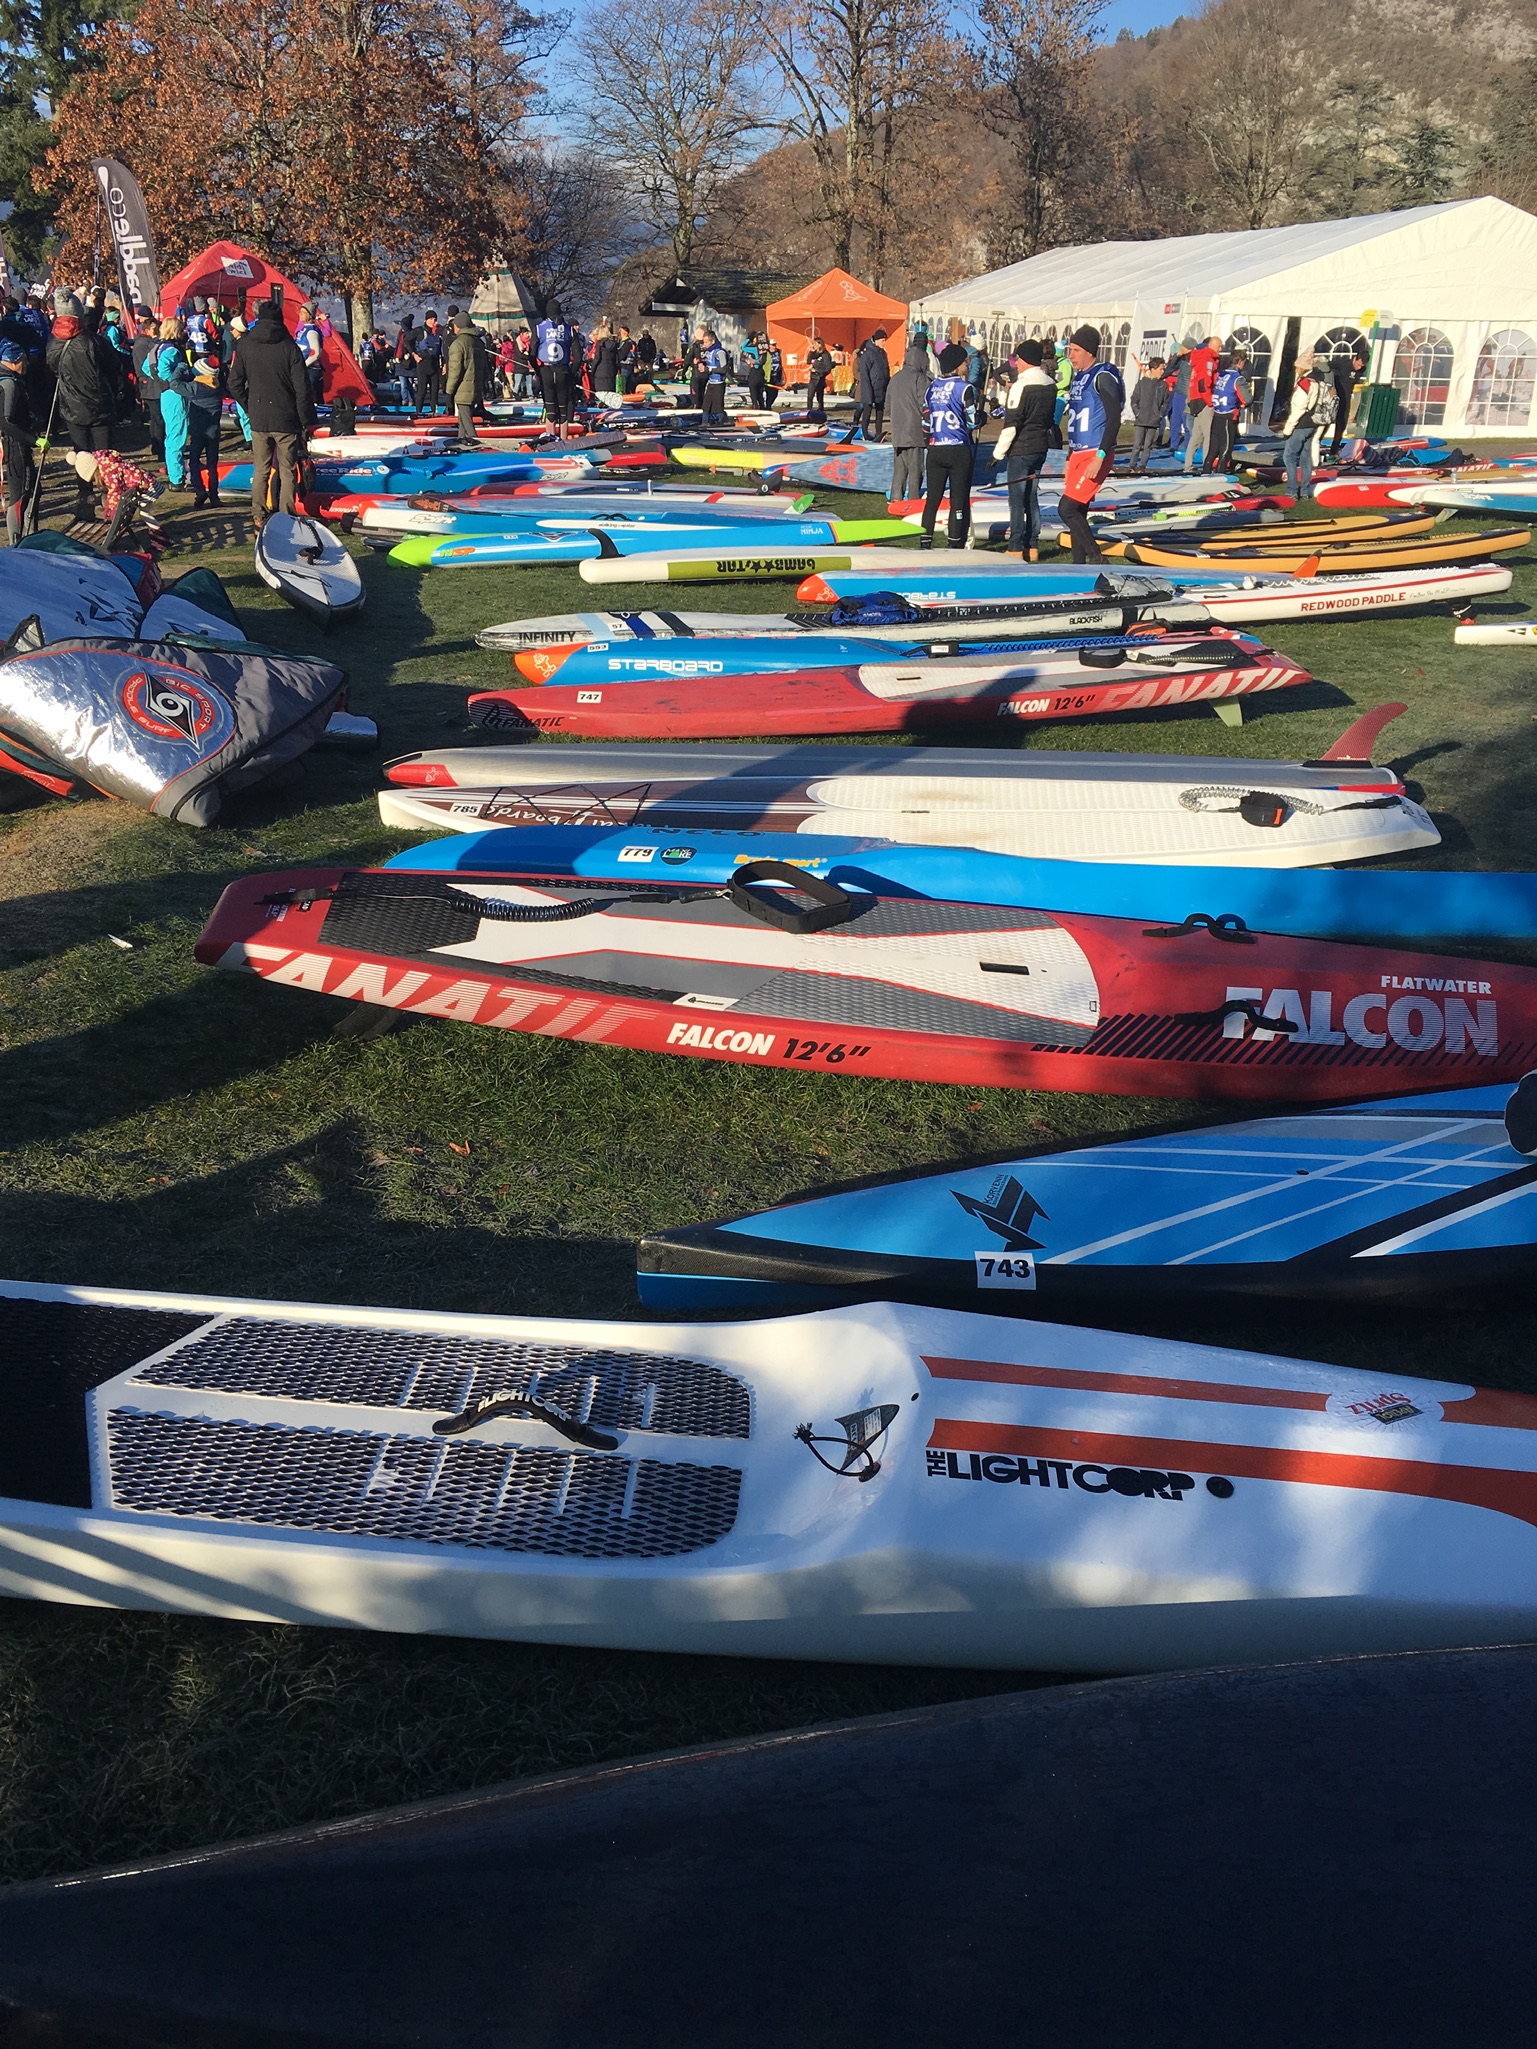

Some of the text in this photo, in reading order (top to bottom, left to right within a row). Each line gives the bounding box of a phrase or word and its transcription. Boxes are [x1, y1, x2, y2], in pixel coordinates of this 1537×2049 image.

[547, 342, 565, 362] 9
[439, 546, 476, 557] NSP
[897, 591, 957, 600] STARBO
[1301, 598, 1360, 612] REDWOOD
[1361, 592, 1407, 605] PADDLE
[1069, 615, 1103, 625] BLACKFISH
[519, 631, 577, 643] INFINITY
[608, 658, 724, 673] STARBOARD
[165, 678, 212, 730] BIC SPORT
[579, 693, 600, 701] 747
[996, 698, 1051, 716] FALCON
[500, 716, 565, 728] FANATIC
[452, 805, 479, 814] 785
[622, 848, 654, 857] 779
[1381, 975, 1493, 995] FLATWATER
[1222, 986, 1499, 1057] FALCON
[666, 1022, 776, 1056] FALCON
[979, 1258, 1031, 1279] 743
[925, 1449, 947, 1477] THE
